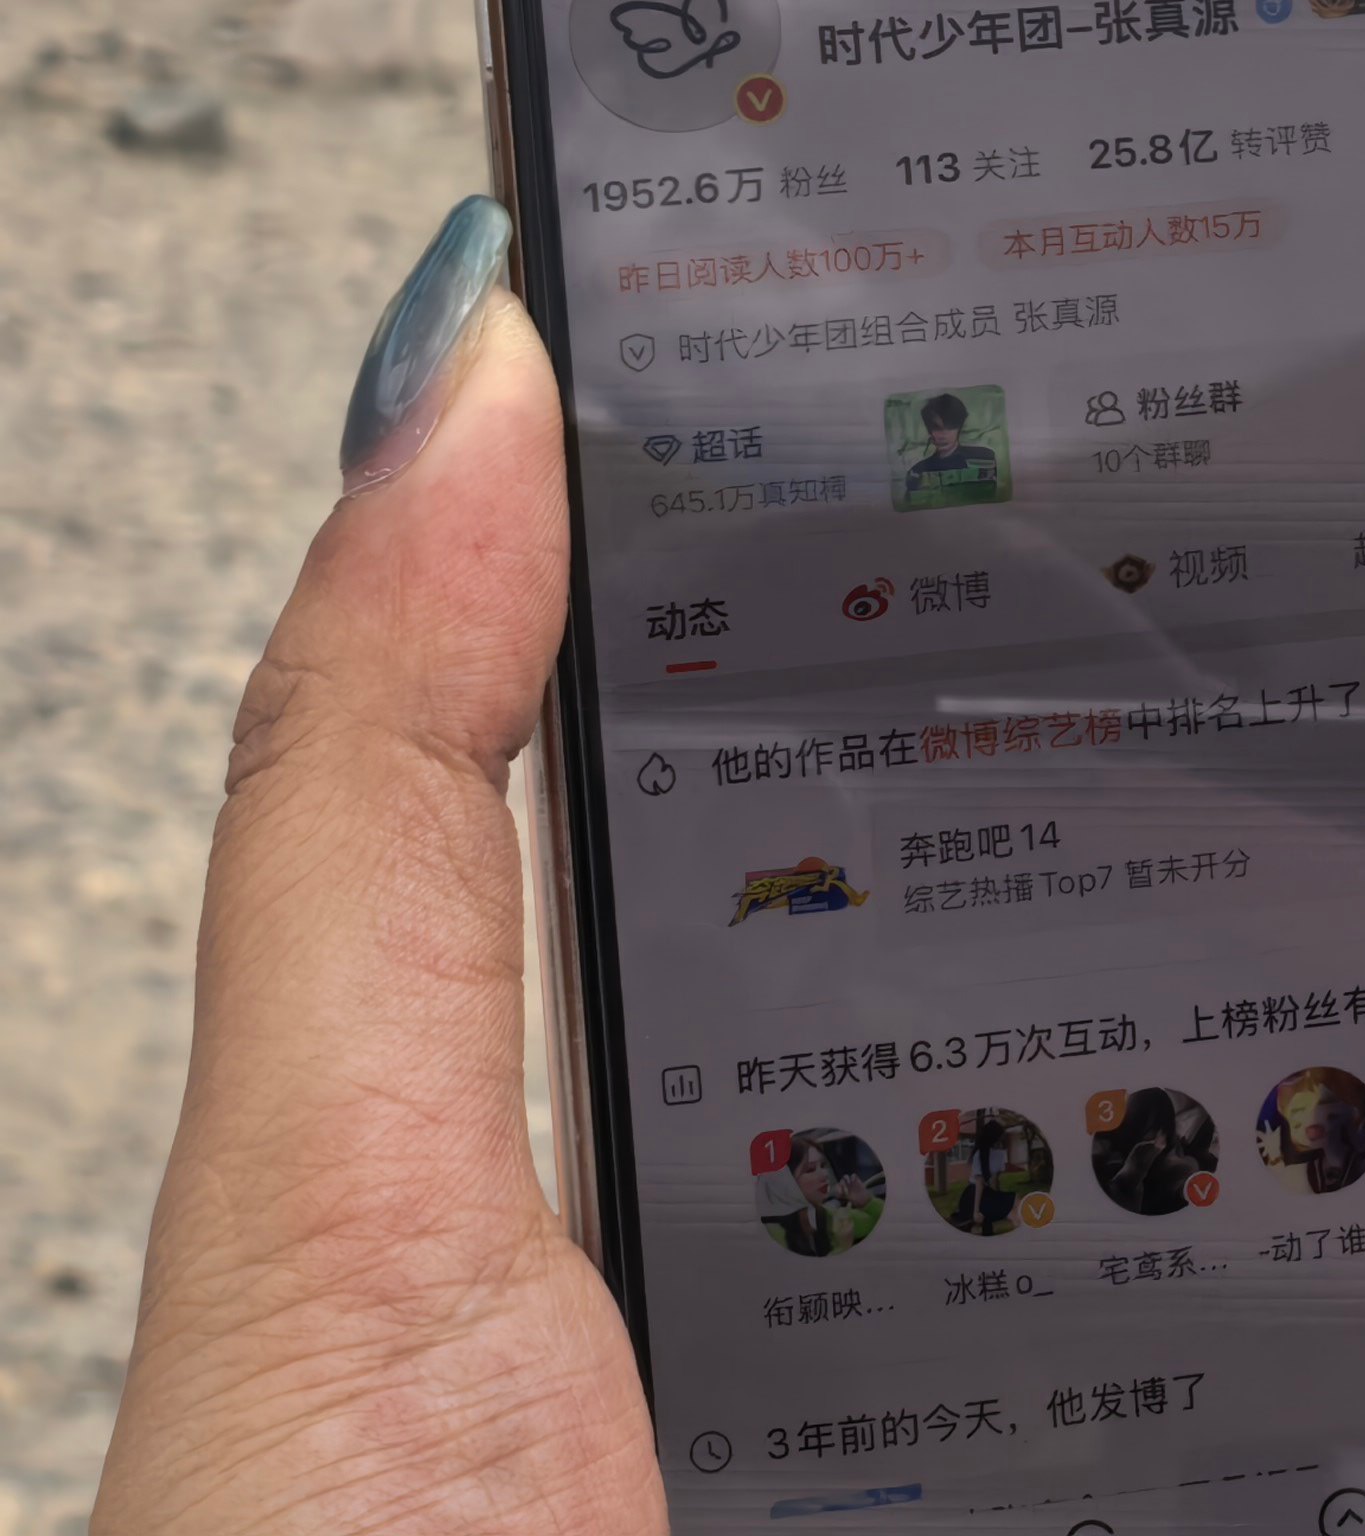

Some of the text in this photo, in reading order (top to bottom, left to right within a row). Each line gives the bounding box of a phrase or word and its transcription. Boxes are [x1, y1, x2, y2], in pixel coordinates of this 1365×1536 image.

[895, 145, 1041, 186] 113 关注
[1088, 121, 1332, 170] 25.8亿 转评赞
[583, 163, 848, 213] 1952.6万 粉丝
[1001, 211, 1265, 259] 本月互动人数15万
[617, 241, 925, 293] 昨日阅读人数100万+
[678, 293, 1120, 364] 时代少年团组合成员 张真源
[1136, 379, 1243, 422] 粉丝群
[692, 425, 763, 465] 超话
[1091, 439, 1211, 473] 10个群聊
[1169, 544, 1249, 589] 视频
[909, 570, 991, 616] 微博
[646, 597, 731, 641] 动态
[711, 680, 1361, 787] 他的作品在微博综艺榜中排名上升了
[1124, 848, 1251, 890] 暂未开分
